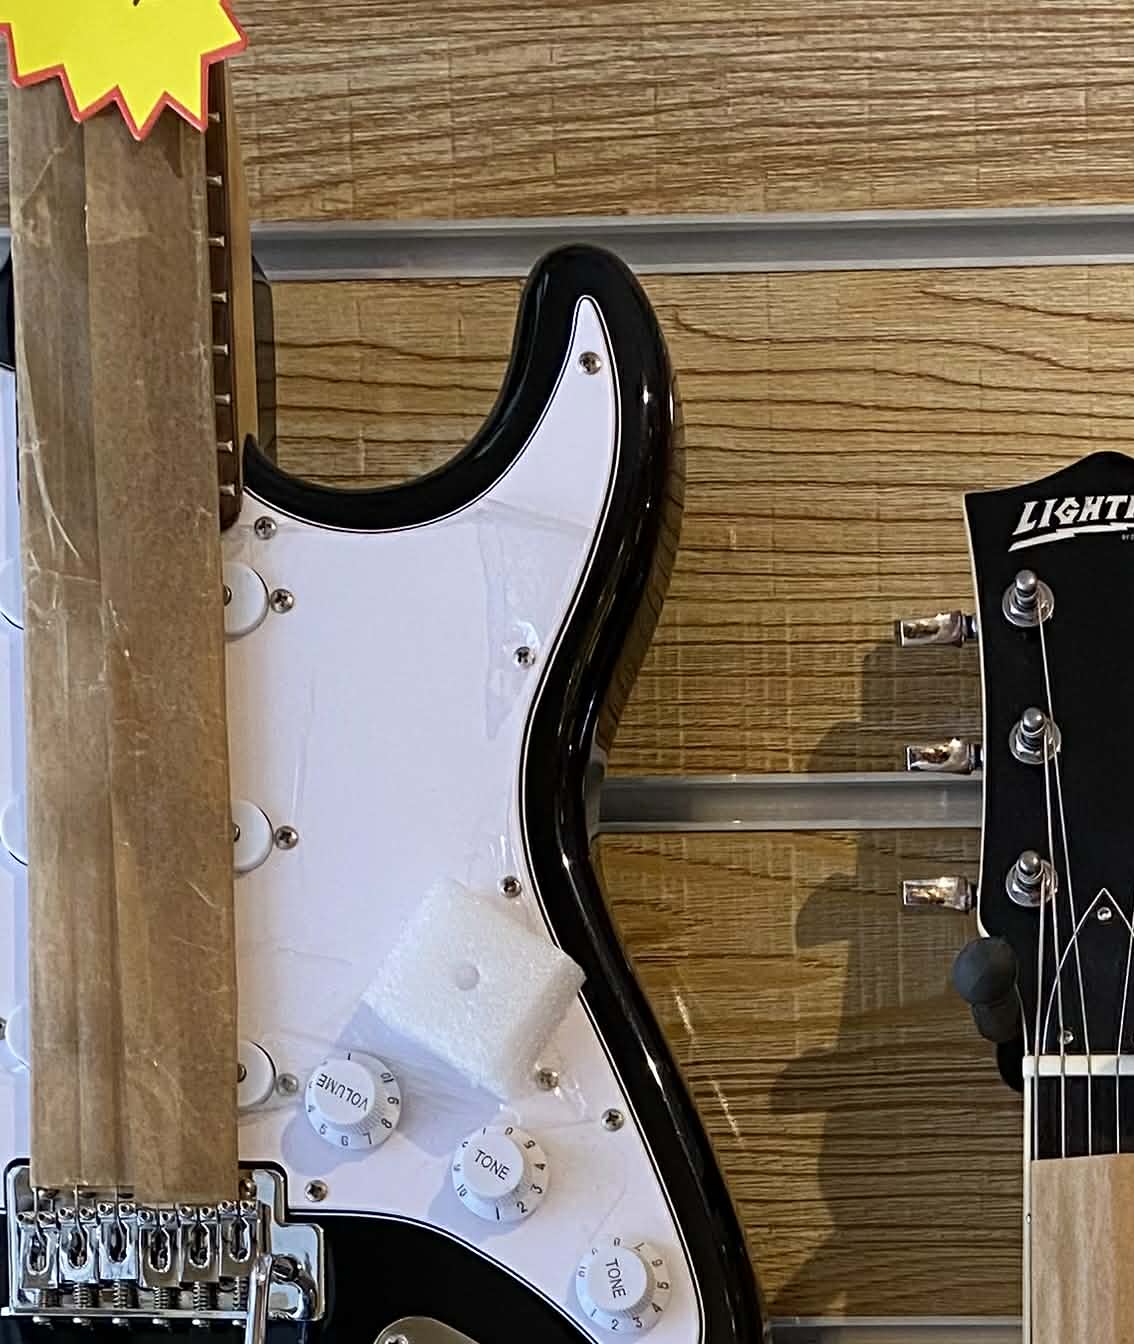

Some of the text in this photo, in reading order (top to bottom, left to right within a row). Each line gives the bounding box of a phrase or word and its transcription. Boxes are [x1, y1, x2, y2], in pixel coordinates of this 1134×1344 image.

[316, 1073, 368, 1112] VOLUME
[474, 1149, 510, 1181] TONE
[516, 1200, 528, 1213] 2
[606, 1258, 627, 1299] TONE
[611, 1318, 619, 1331] 2
